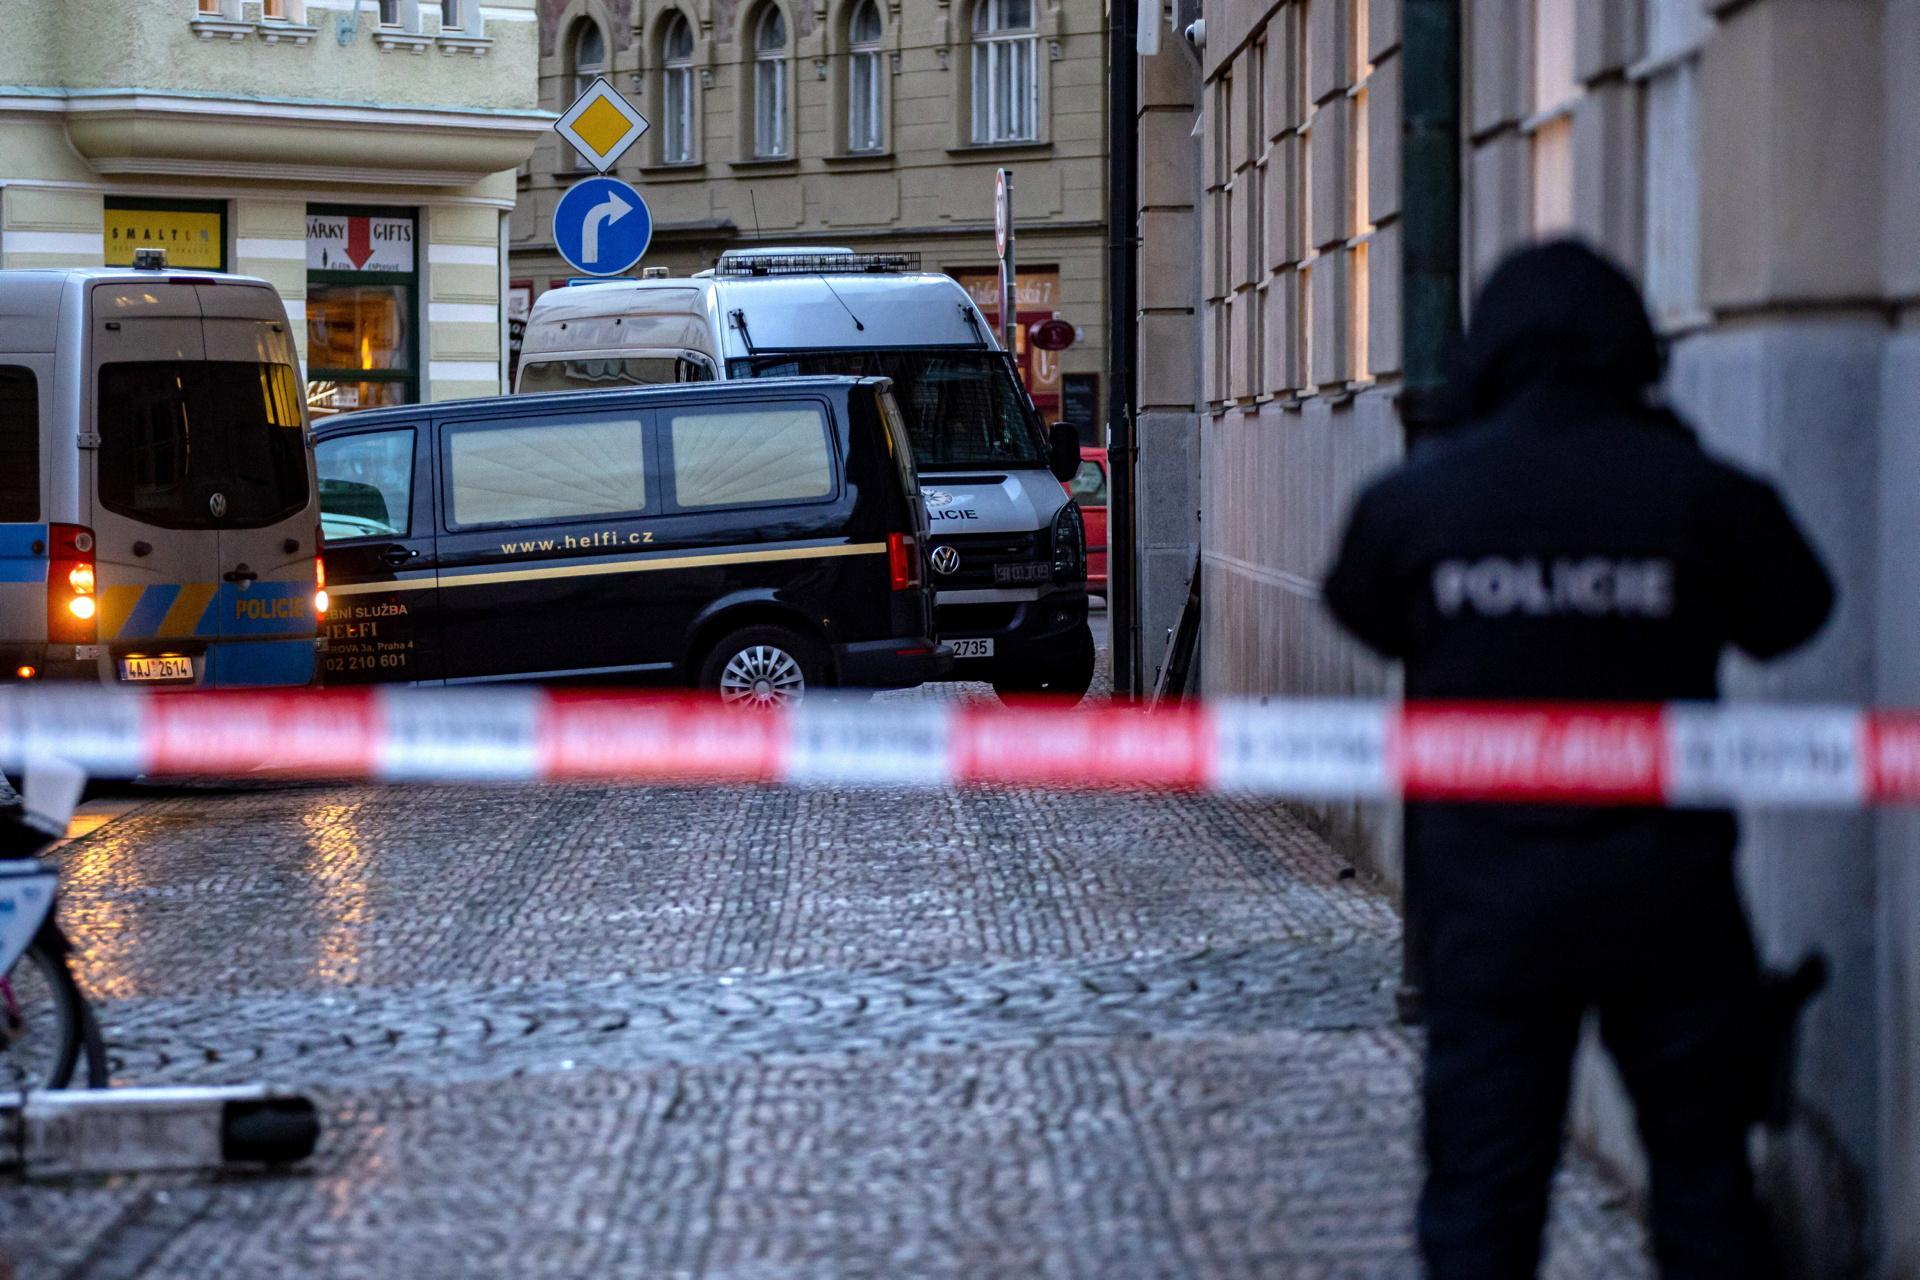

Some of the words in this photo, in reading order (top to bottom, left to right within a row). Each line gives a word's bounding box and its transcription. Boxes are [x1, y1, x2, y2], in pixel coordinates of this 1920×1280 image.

[374, 223, 411, 241] GIFTS
[929, 509, 979, 521] LICIE
[501, 531, 654, 554] www.helfi.cz
[355, 603, 409, 618] SLUŽBA
[377, 641, 405, 651] Praha
[407, 640, 414, 649] 4
[953, 640, 988, 656] 2735
[129, 661, 151, 678] 4AJ
[158, 659, 187, 677] 2614
[326, 658, 344, 671] 02
[348, 655, 376, 670] 210
[380, 653, 406, 668] 601
